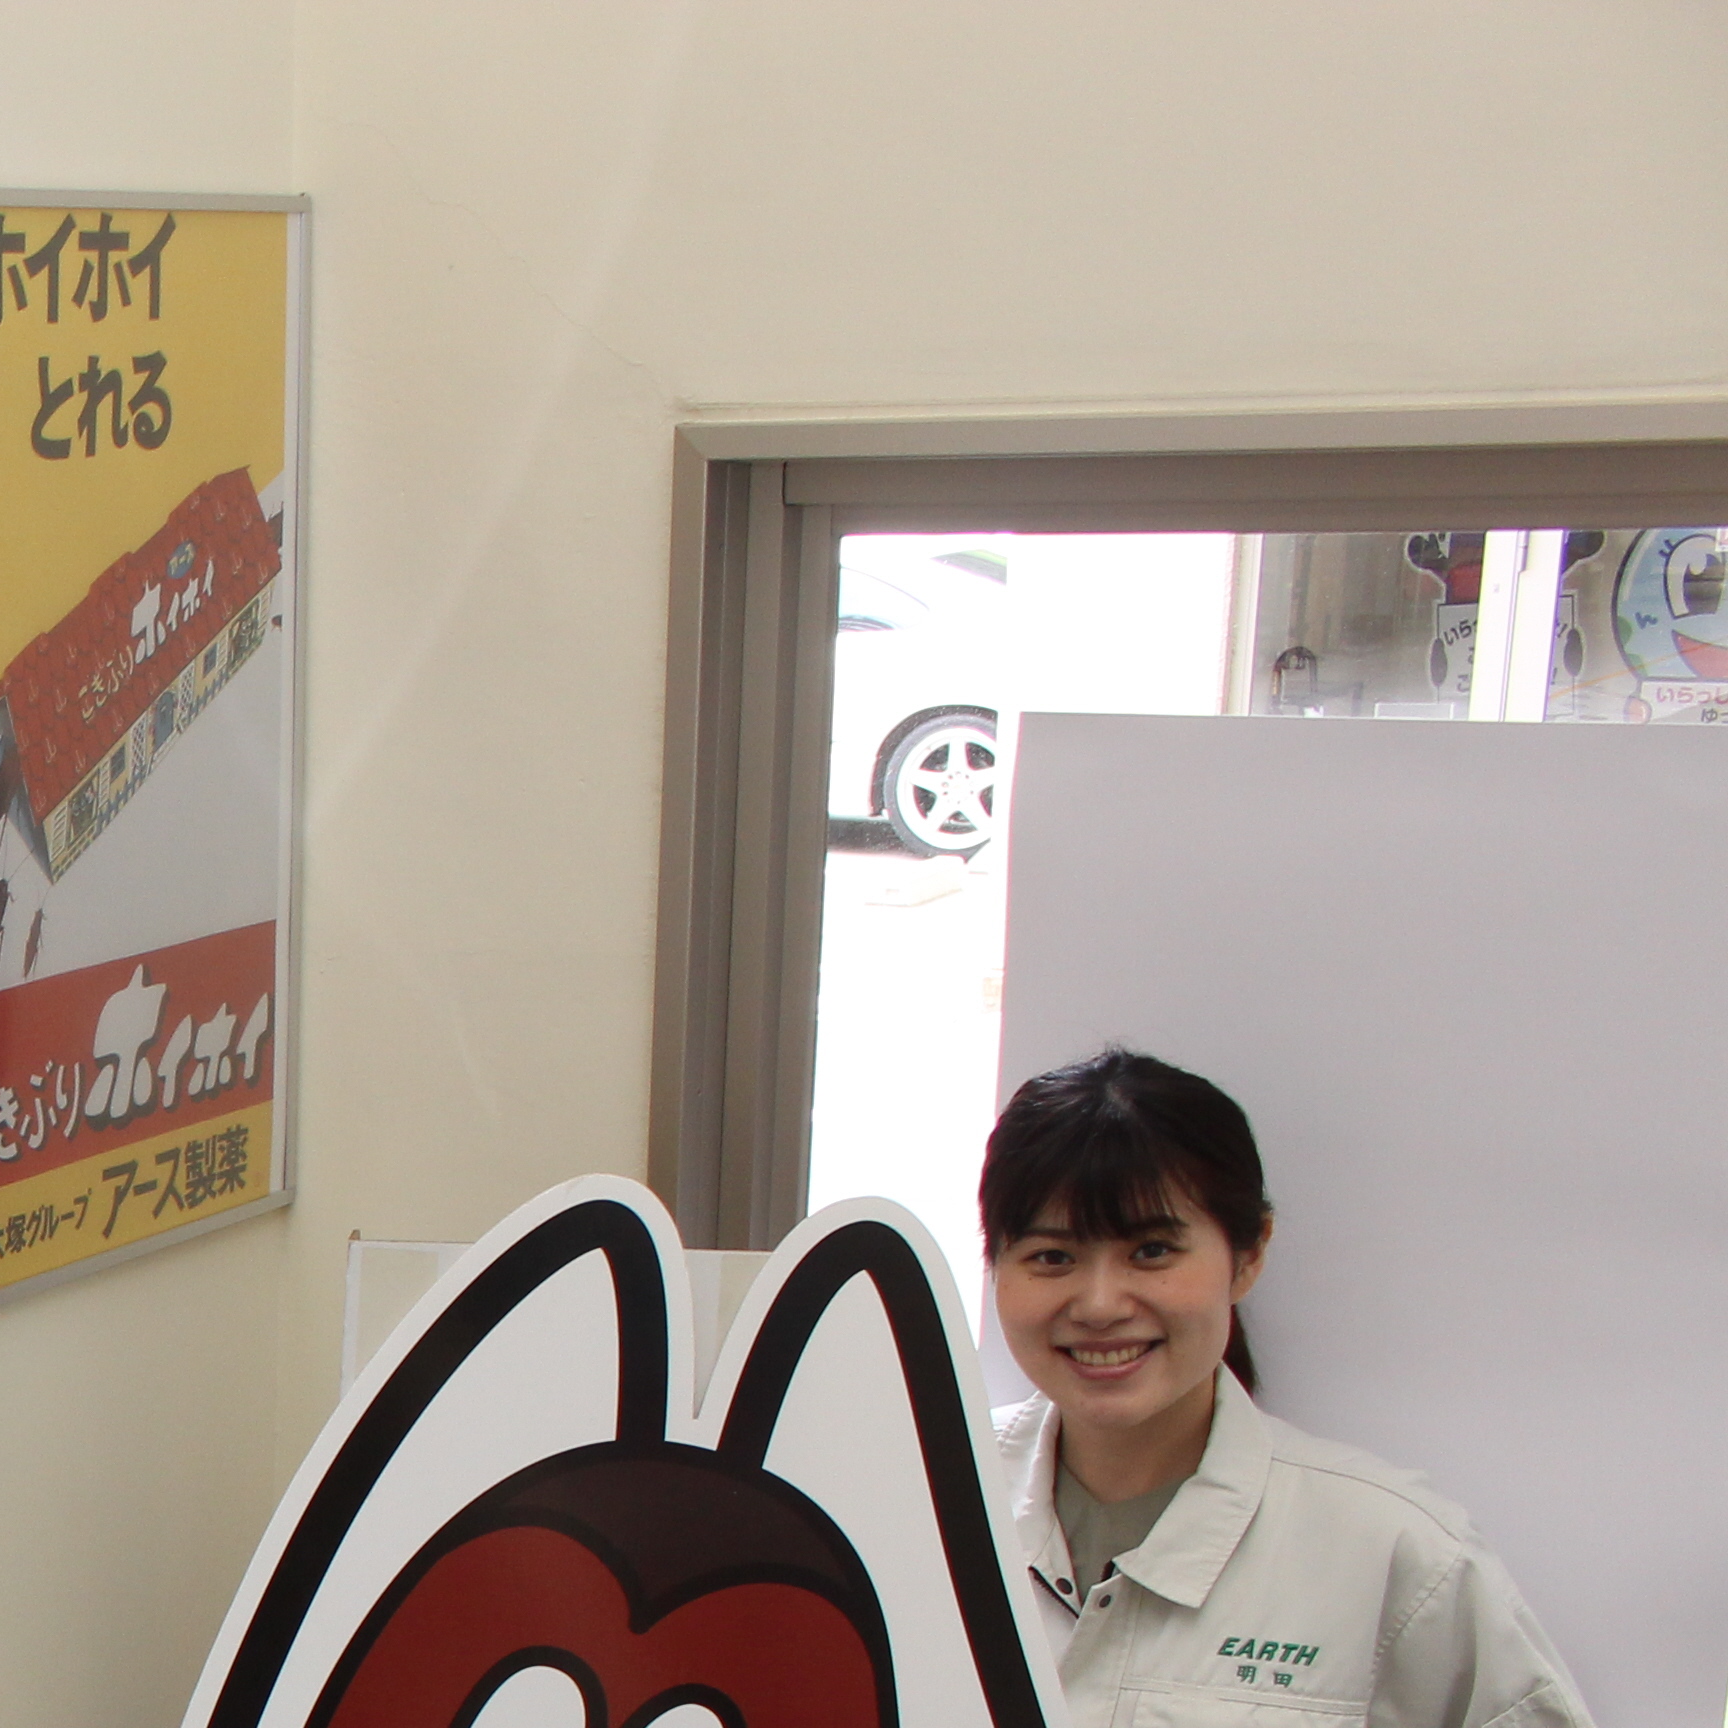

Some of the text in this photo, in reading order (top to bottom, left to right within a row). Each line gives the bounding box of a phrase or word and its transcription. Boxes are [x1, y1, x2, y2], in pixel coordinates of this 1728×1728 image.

[30, 350, 174, 460] とれる
[130, 558, 214, 664] ホイホイ
[85, 963, 272, 1125] ホイホイ
[101, 1124, 250, 1239] アース製薬
[1216, 1636, 1320, 1668] EARTH
